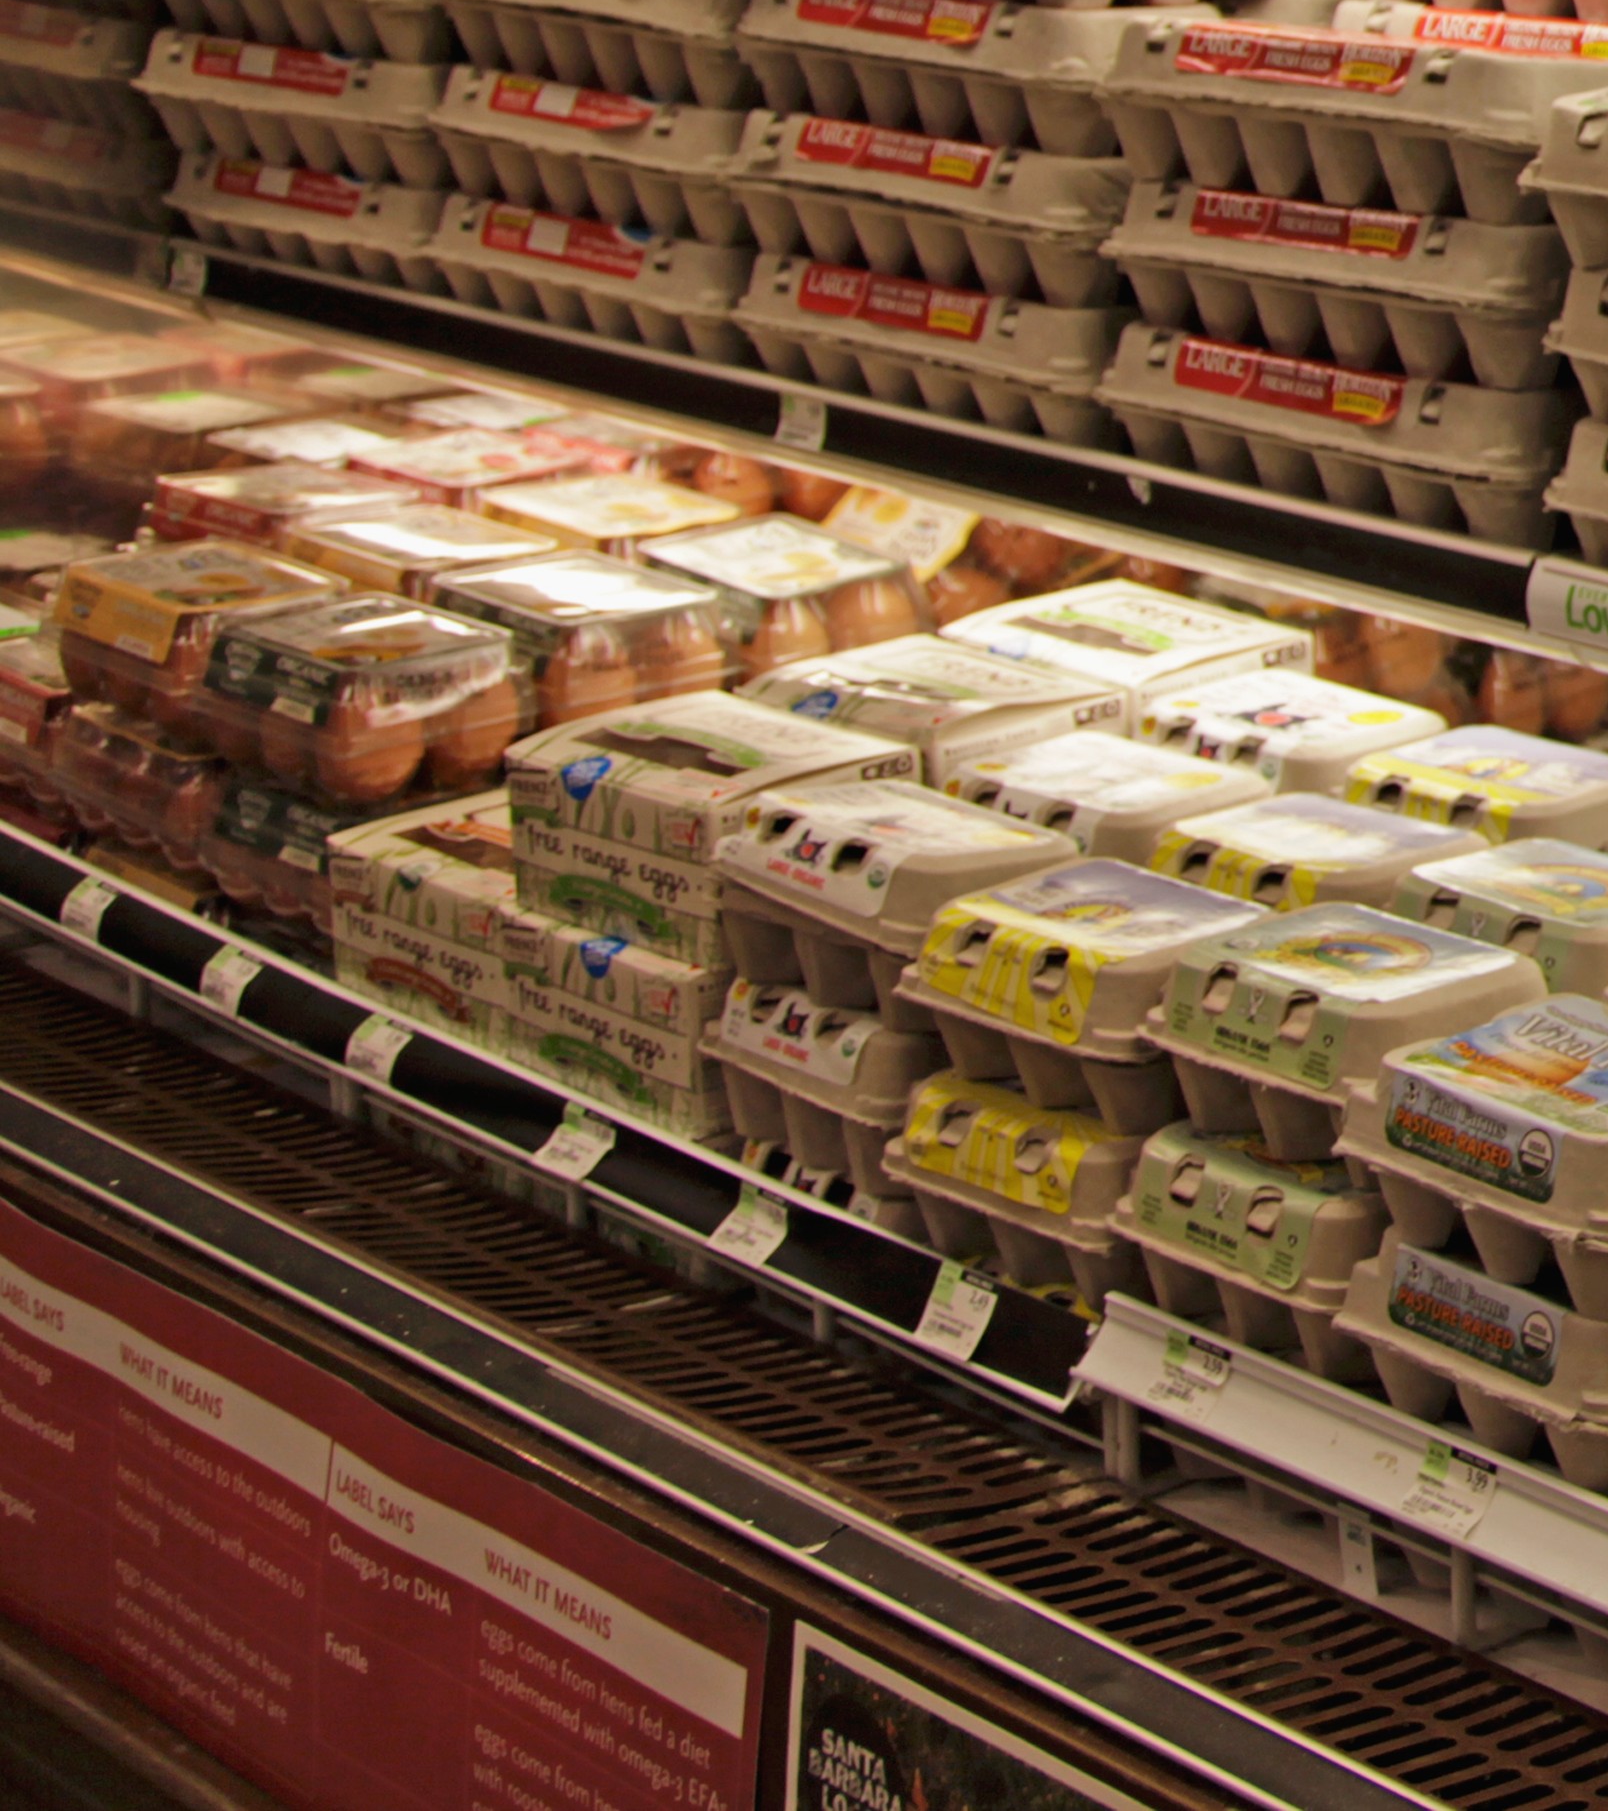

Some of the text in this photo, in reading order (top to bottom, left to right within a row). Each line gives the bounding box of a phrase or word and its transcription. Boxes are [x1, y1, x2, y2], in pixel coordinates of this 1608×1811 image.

[1421, 13, 1489, 42] LARGE
[1184, 343, 1245, 376] LARGE
[637, 861, 689, 903] eggs
[336, 1468, 414, 1535] LABEL SAYS
[329, 1532, 452, 1616] Omega-3 or DHA
[484, 1548, 612, 1641] WHAT IT MEANS
[325, 1632, 368, 1676] Fertile
[481, 1617, 710, 1770] eggs come from hens fed a diet
[821, 1729, 886, 1784] SANTA
